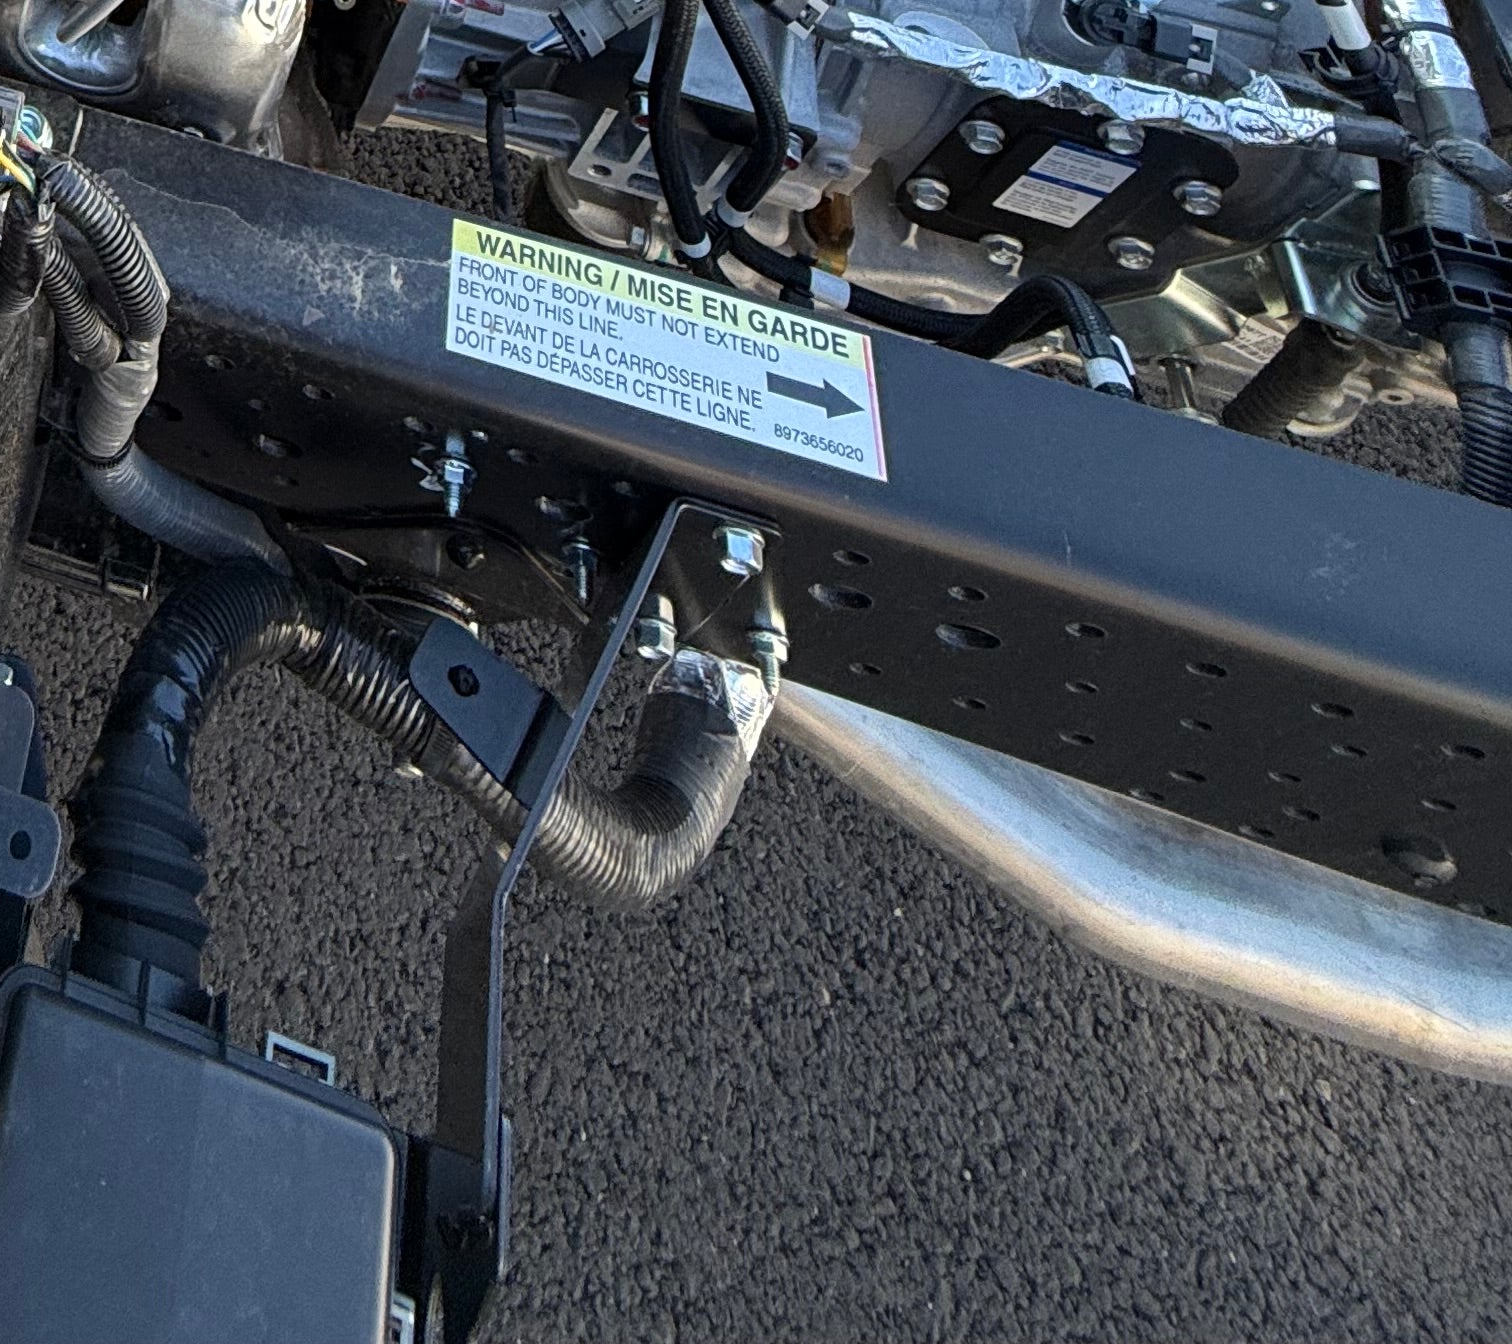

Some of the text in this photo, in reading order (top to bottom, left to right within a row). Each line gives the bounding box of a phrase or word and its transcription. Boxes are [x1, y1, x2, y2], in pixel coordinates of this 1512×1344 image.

[457, 277, 624, 342] BEYOND THIS LINE.
[459, 256, 781, 363] FRONT OF BODY MUST NOT EXTEND
[476, 230, 850, 359] WARNING / MISE EN GARDE
[454, 325, 756, 433] DOIT PAS DÉPASSER CETTE LIGNE.
[456, 303, 764, 410] LE DEVANT DE LA CARROSSERIE NE
[773, 422, 864, 463] 8973656020
